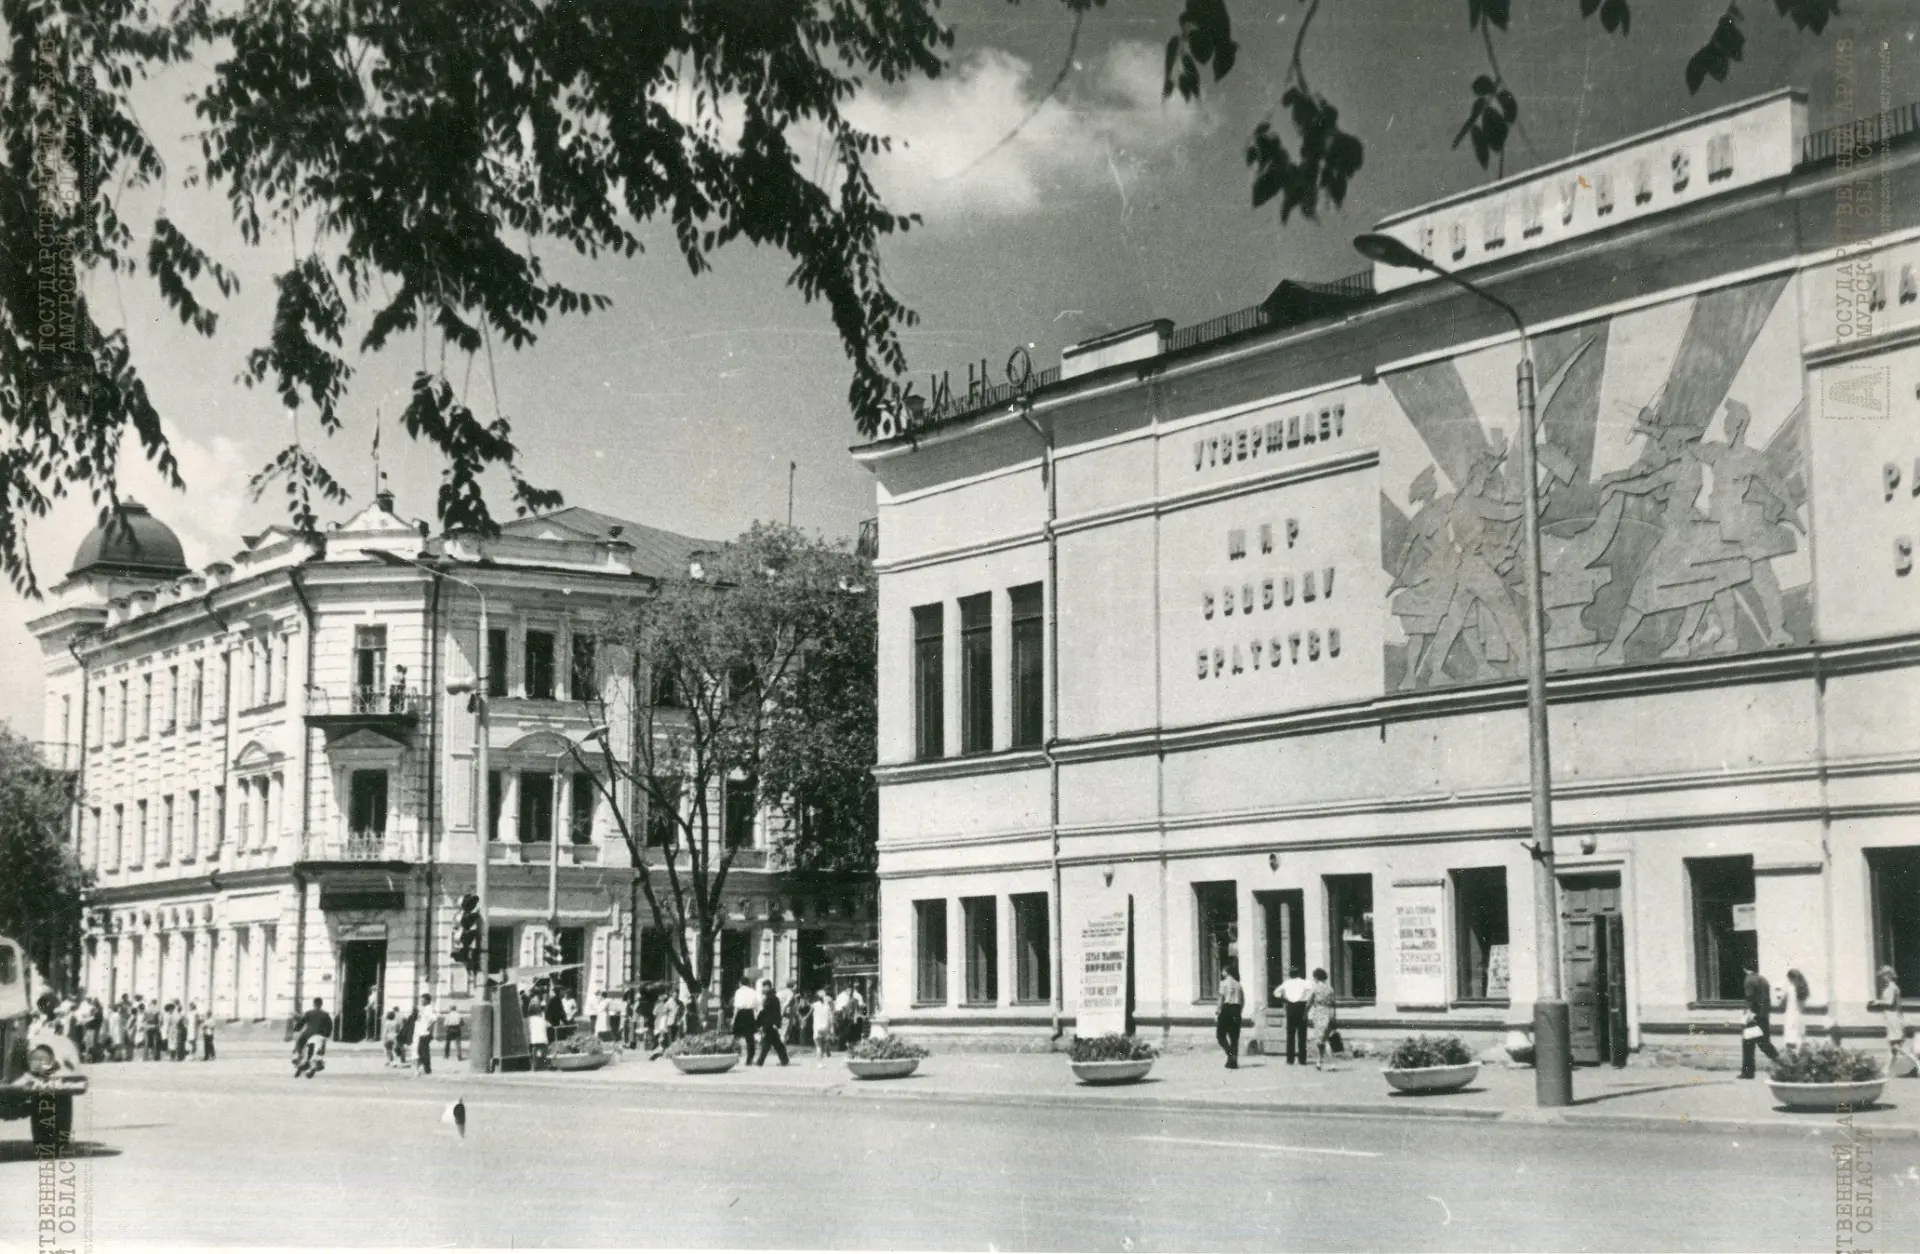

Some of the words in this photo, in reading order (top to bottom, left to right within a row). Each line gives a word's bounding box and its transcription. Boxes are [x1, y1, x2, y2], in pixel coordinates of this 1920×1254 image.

[1419, 130, 1733, 262] КОММУНИЗМ
[1194, 402, 1345, 472] УТВЕРЖДАЕТ
[1227, 517, 1299, 561] МИР
[1202, 566, 1335, 620] СВОБОДУ
[1196, 627, 1341, 680] БРАТСТВО
